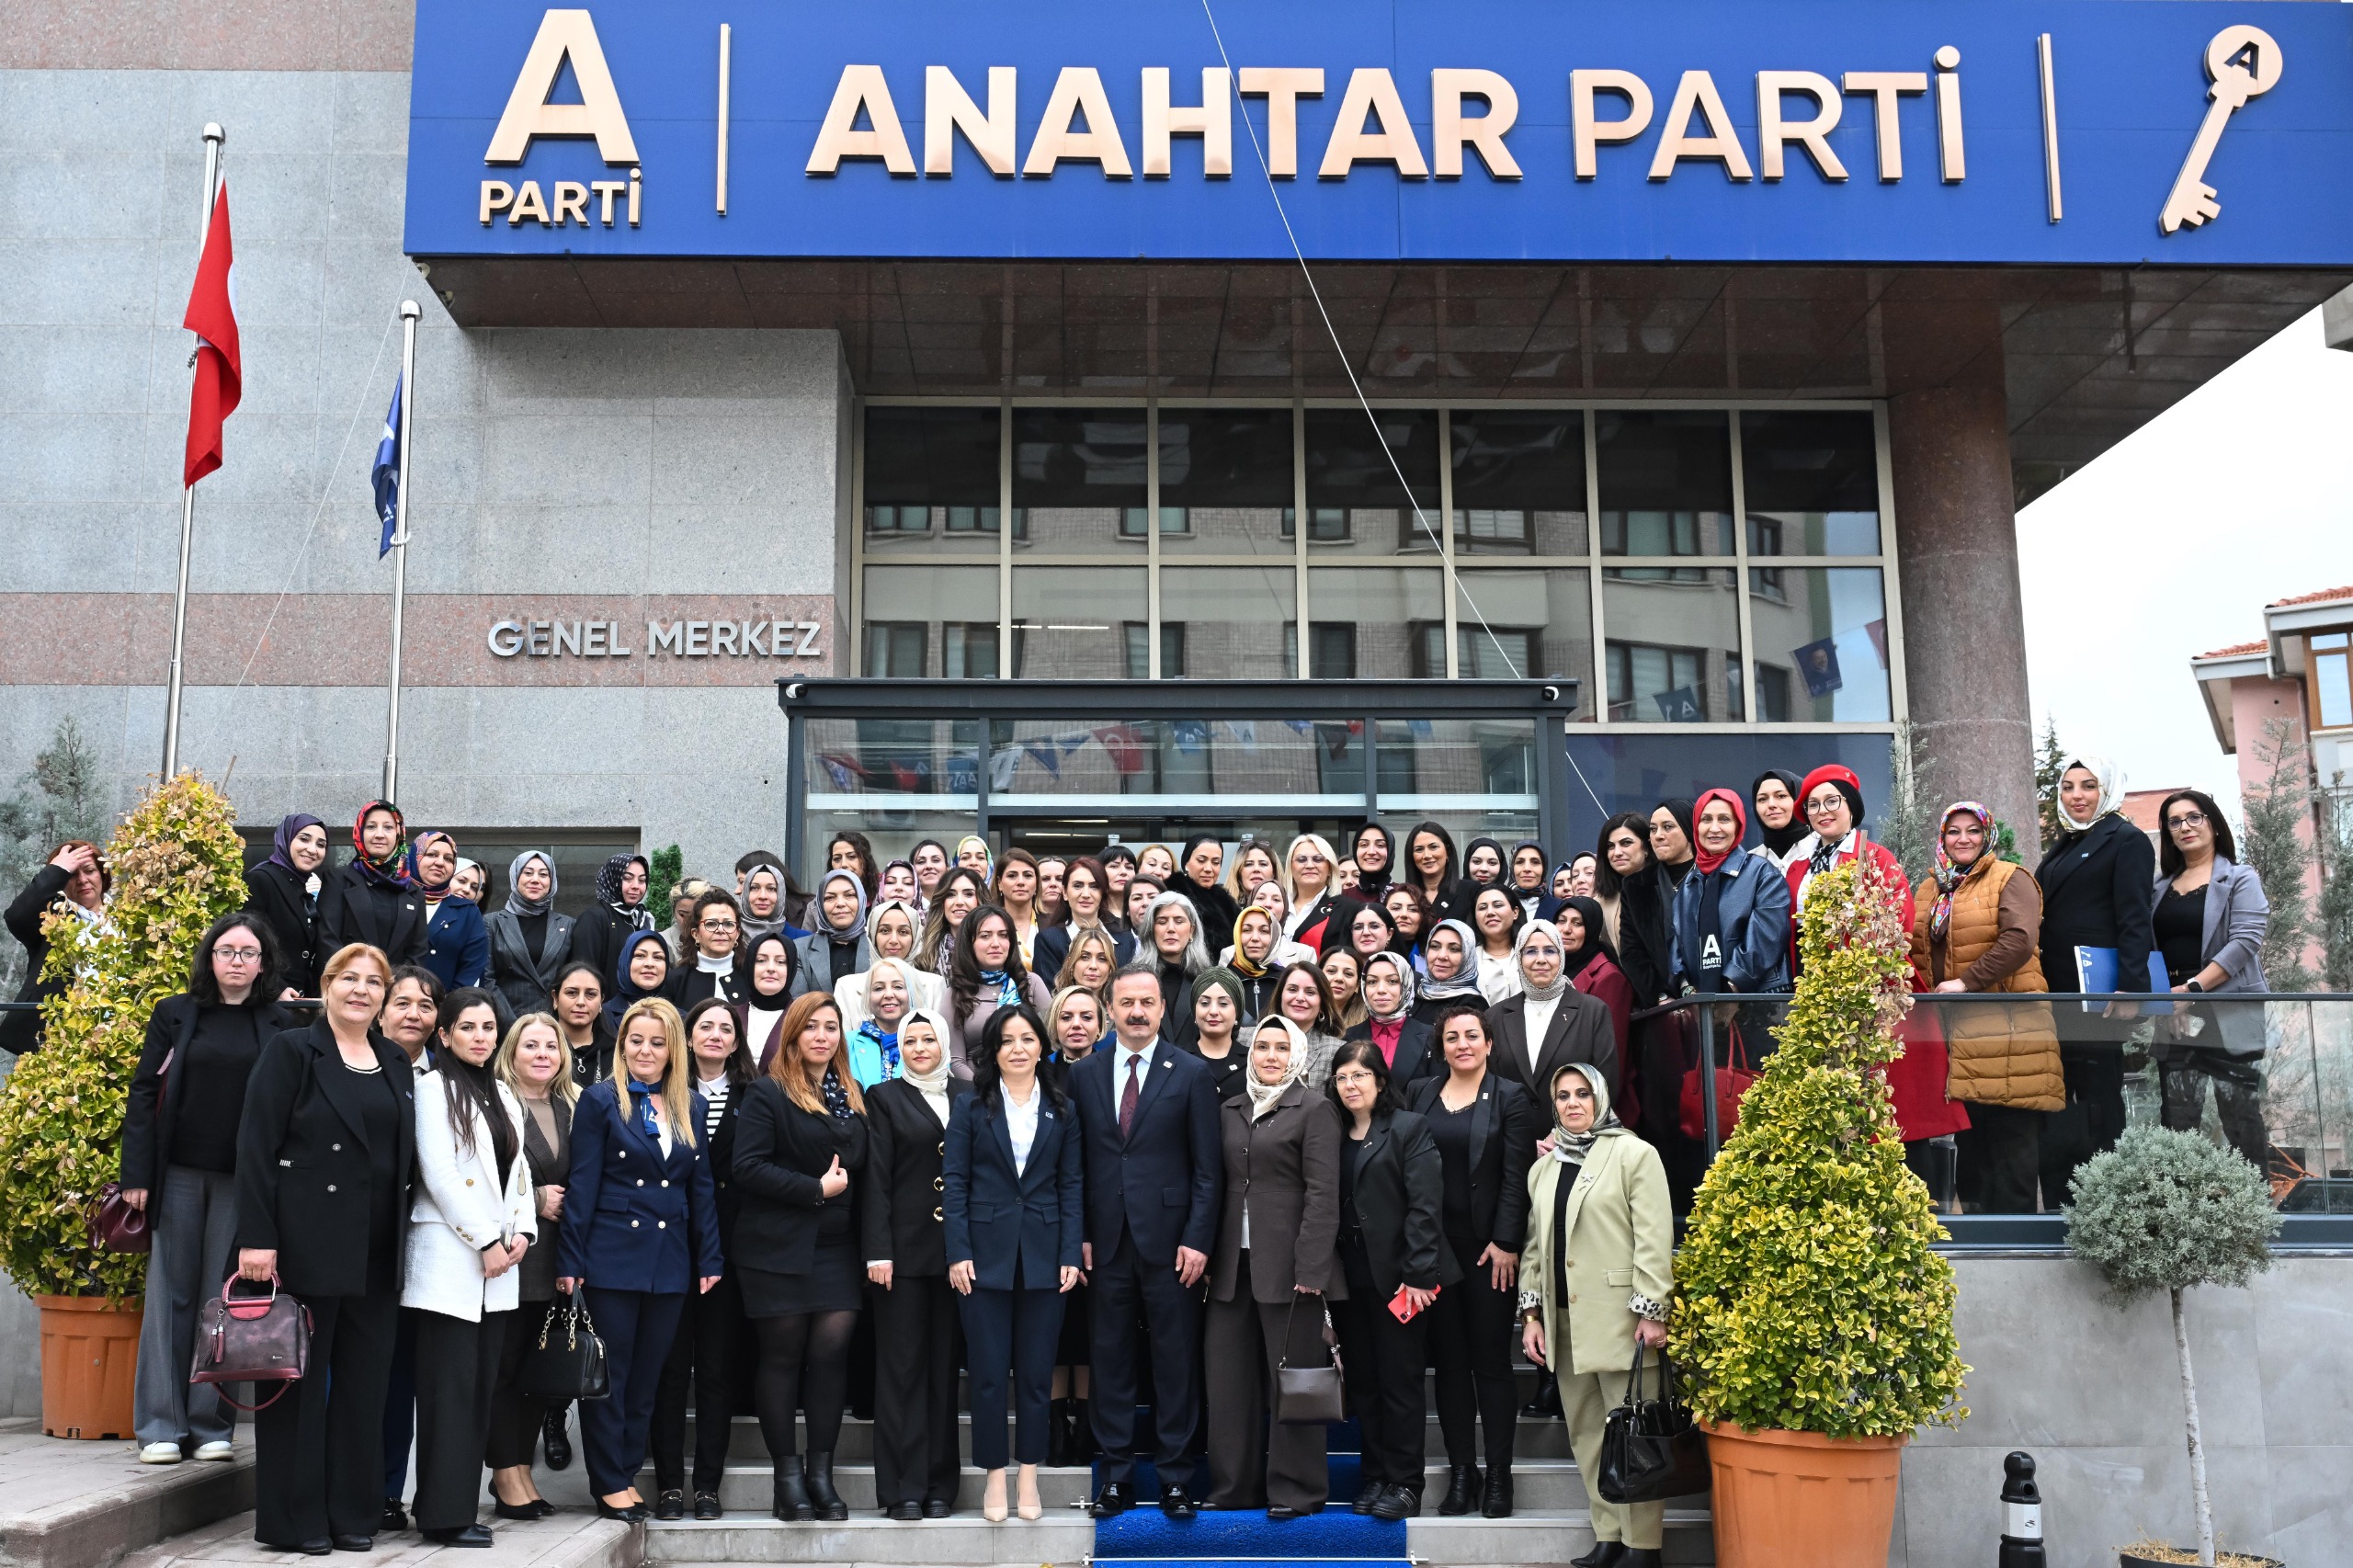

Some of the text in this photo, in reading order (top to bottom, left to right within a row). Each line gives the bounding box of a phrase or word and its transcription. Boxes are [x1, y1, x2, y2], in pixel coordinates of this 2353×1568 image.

[2223, 40, 2260, 81] A
[483, 8, 642, 166] A
[805, 45, 1966, 184] ANAHTAR PARTİ
[479, 168, 642, 228] PARTİ
[487, 619, 821, 657] GENEL MERKEZ
[1702, 934, 1722, 958] A
